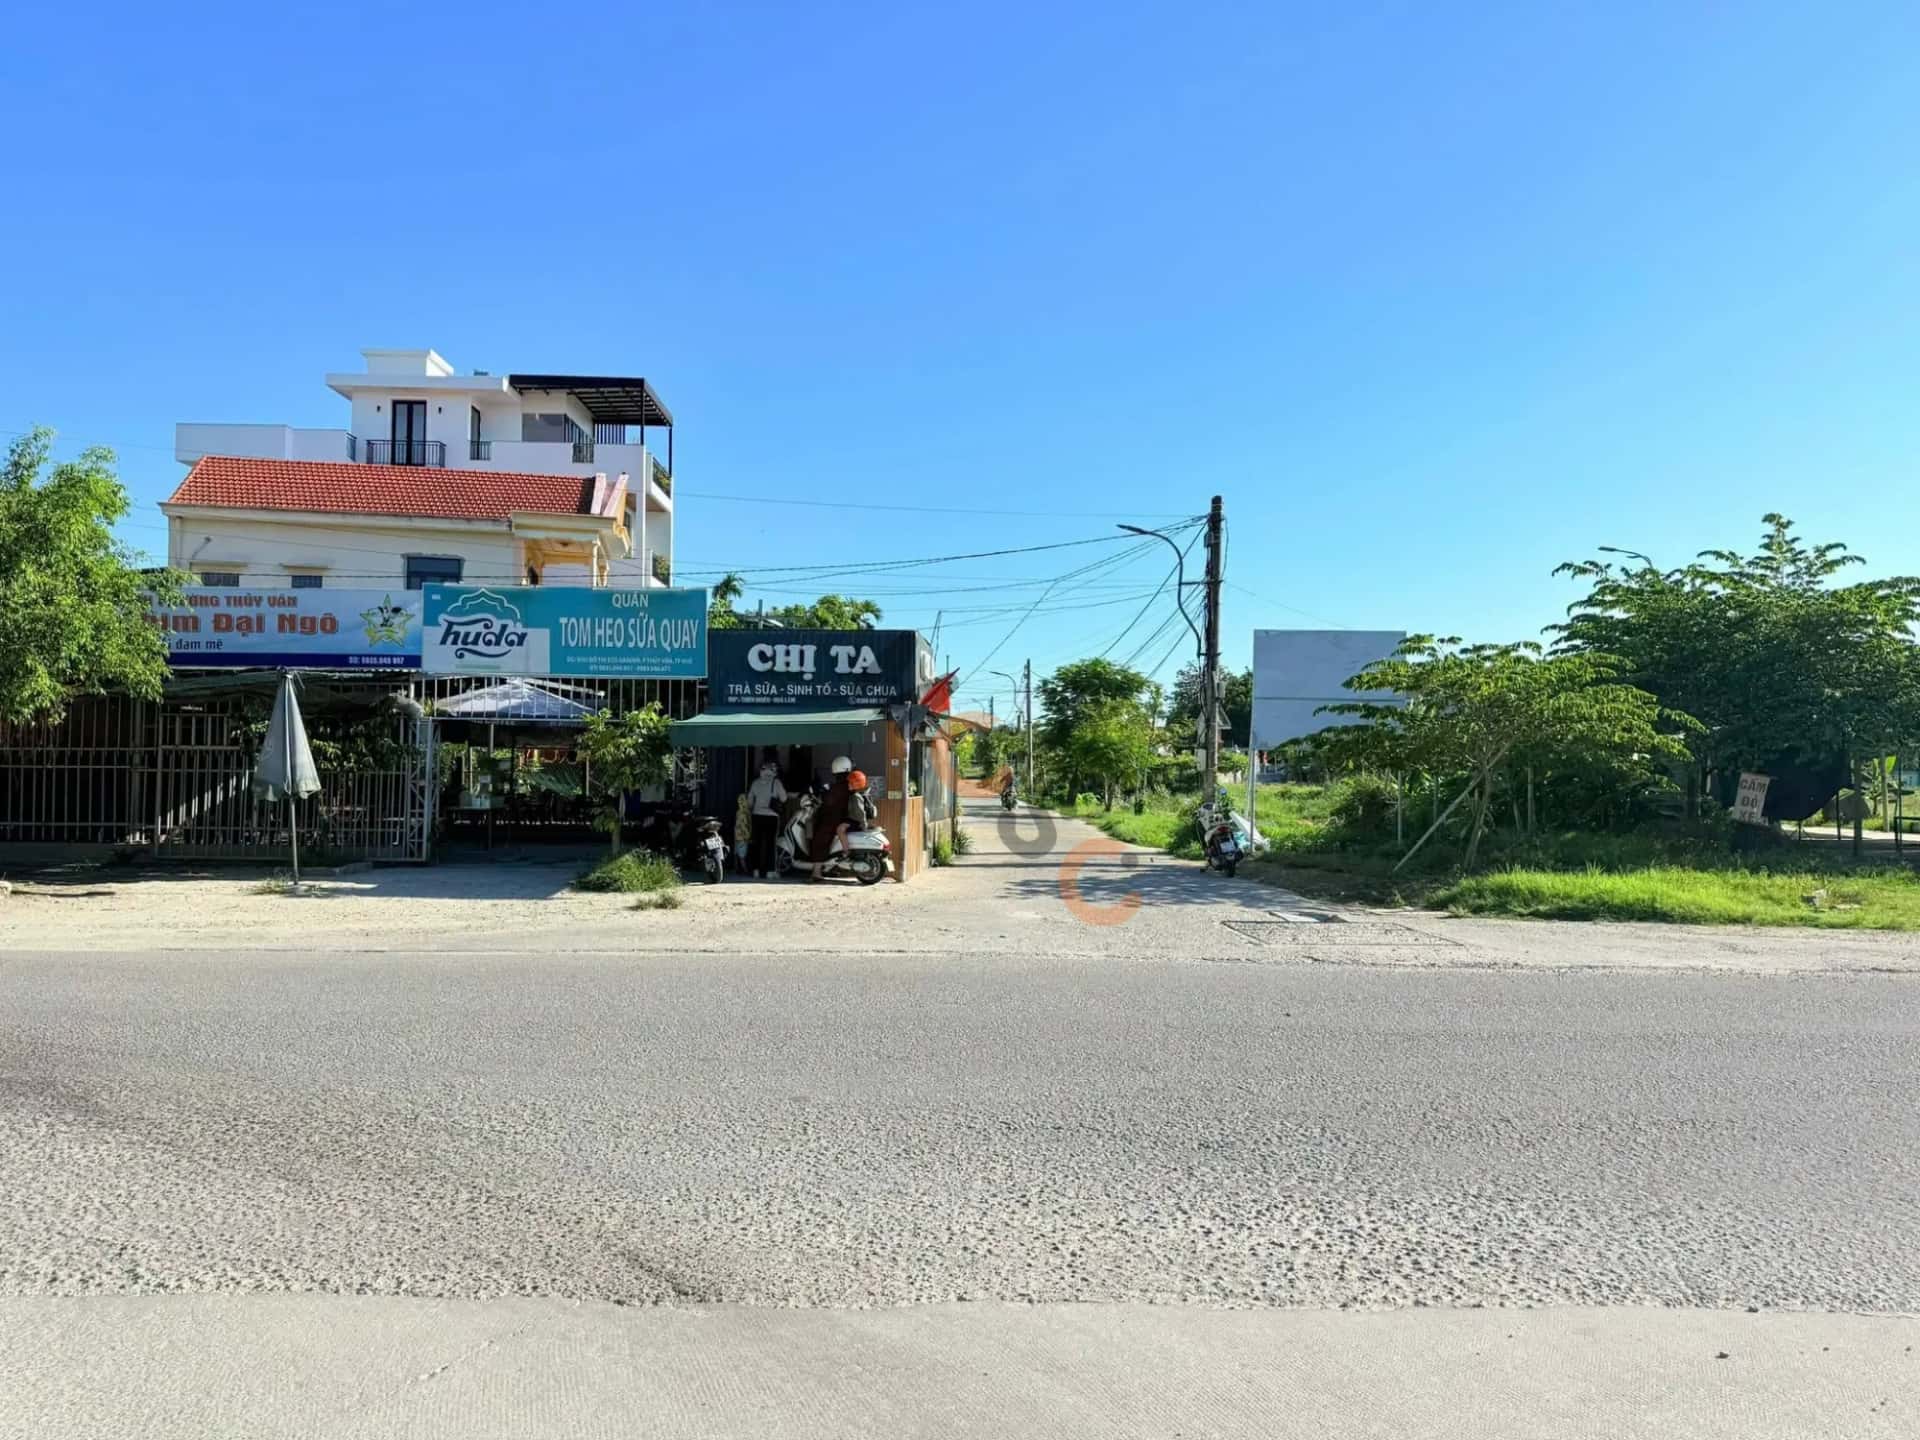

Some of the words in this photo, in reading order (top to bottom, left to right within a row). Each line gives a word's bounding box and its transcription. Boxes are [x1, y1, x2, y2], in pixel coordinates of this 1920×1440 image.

[212, 613, 265, 637] Đại
[278, 612, 339, 635] Ngô
[440, 618, 528, 650] huda
[559, 617, 591, 648] TOM
[595, 617, 625, 648] HEO
[628, 611, 657, 648] SỮA
[660, 619, 699, 652] QUAY
[747, 643, 817, 680] CHỊ
[830, 645, 882, 674] TA
[728, 680, 751, 695] TRÀ
[754, 681, 778, 695] SỮA
[786, 684, 813, 696] SINH
[816, 681, 832, 696] TỐ
